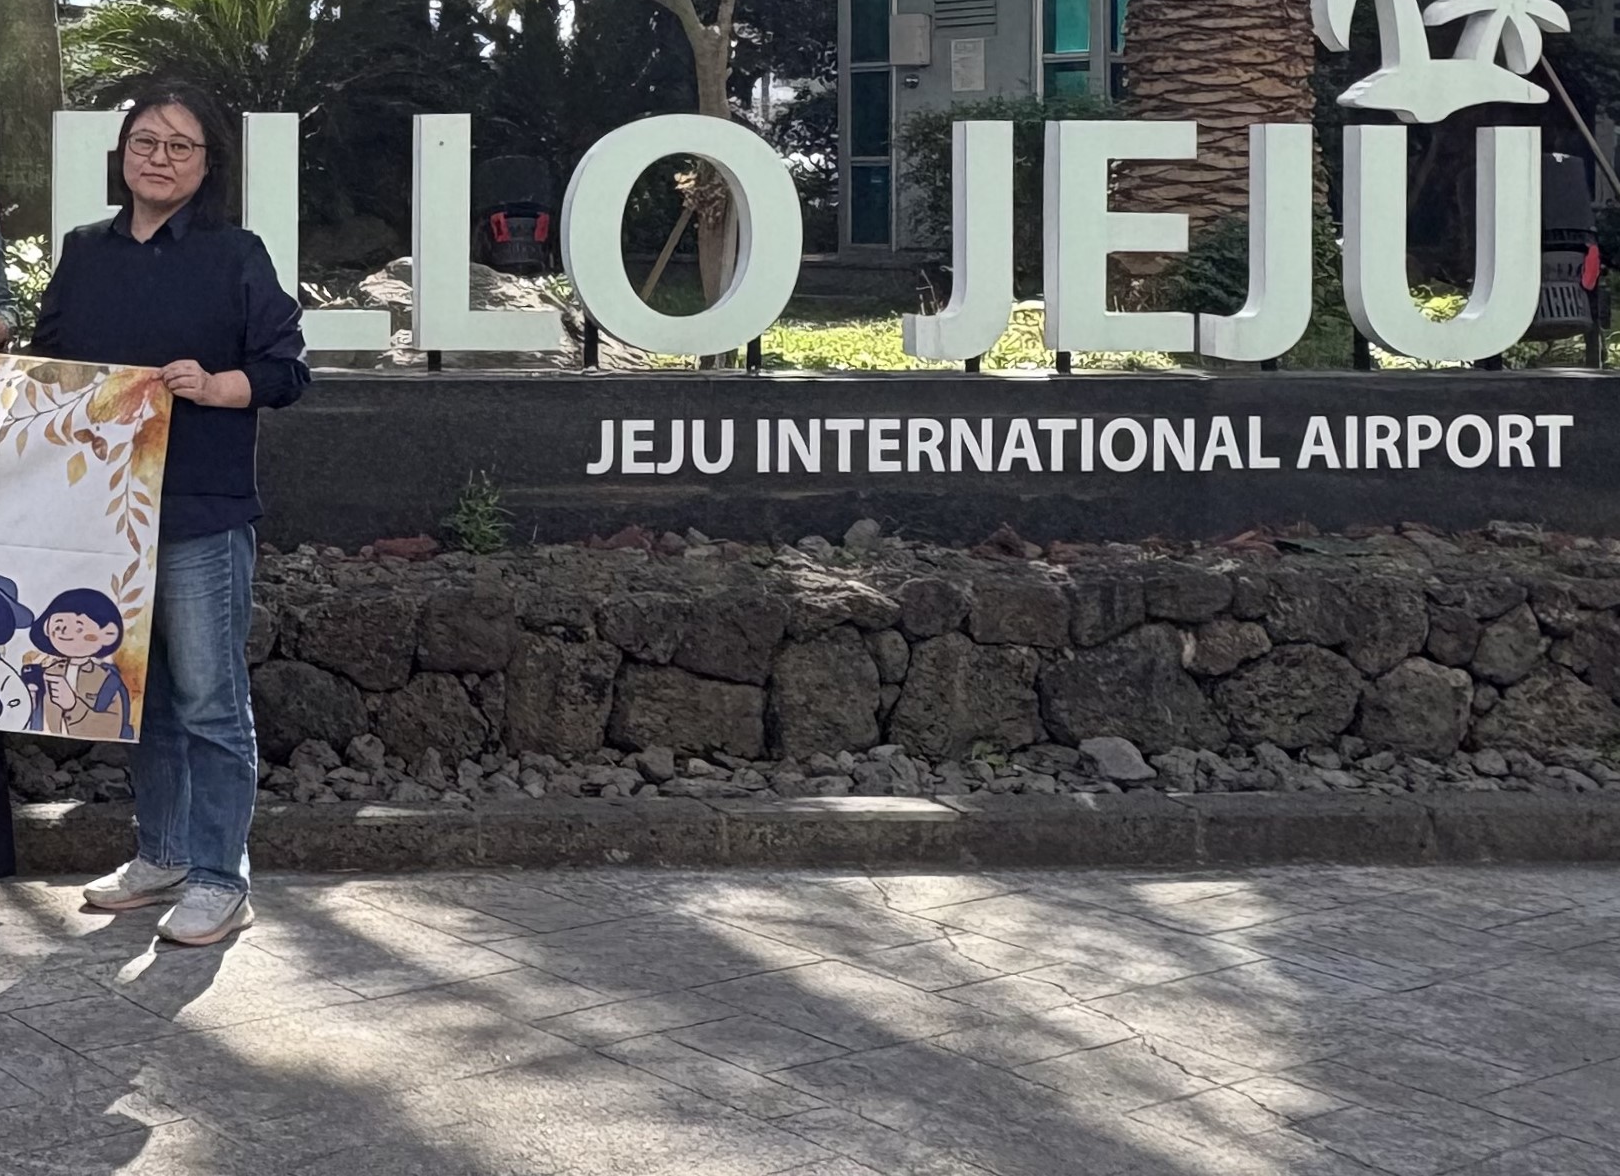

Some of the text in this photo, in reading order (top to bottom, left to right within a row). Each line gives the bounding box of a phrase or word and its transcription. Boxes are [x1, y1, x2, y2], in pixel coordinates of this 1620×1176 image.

[903, 119, 1543, 362] JEJU
[586, 413, 1575, 475] JEJU INTERNATIONAL AIRPORT
